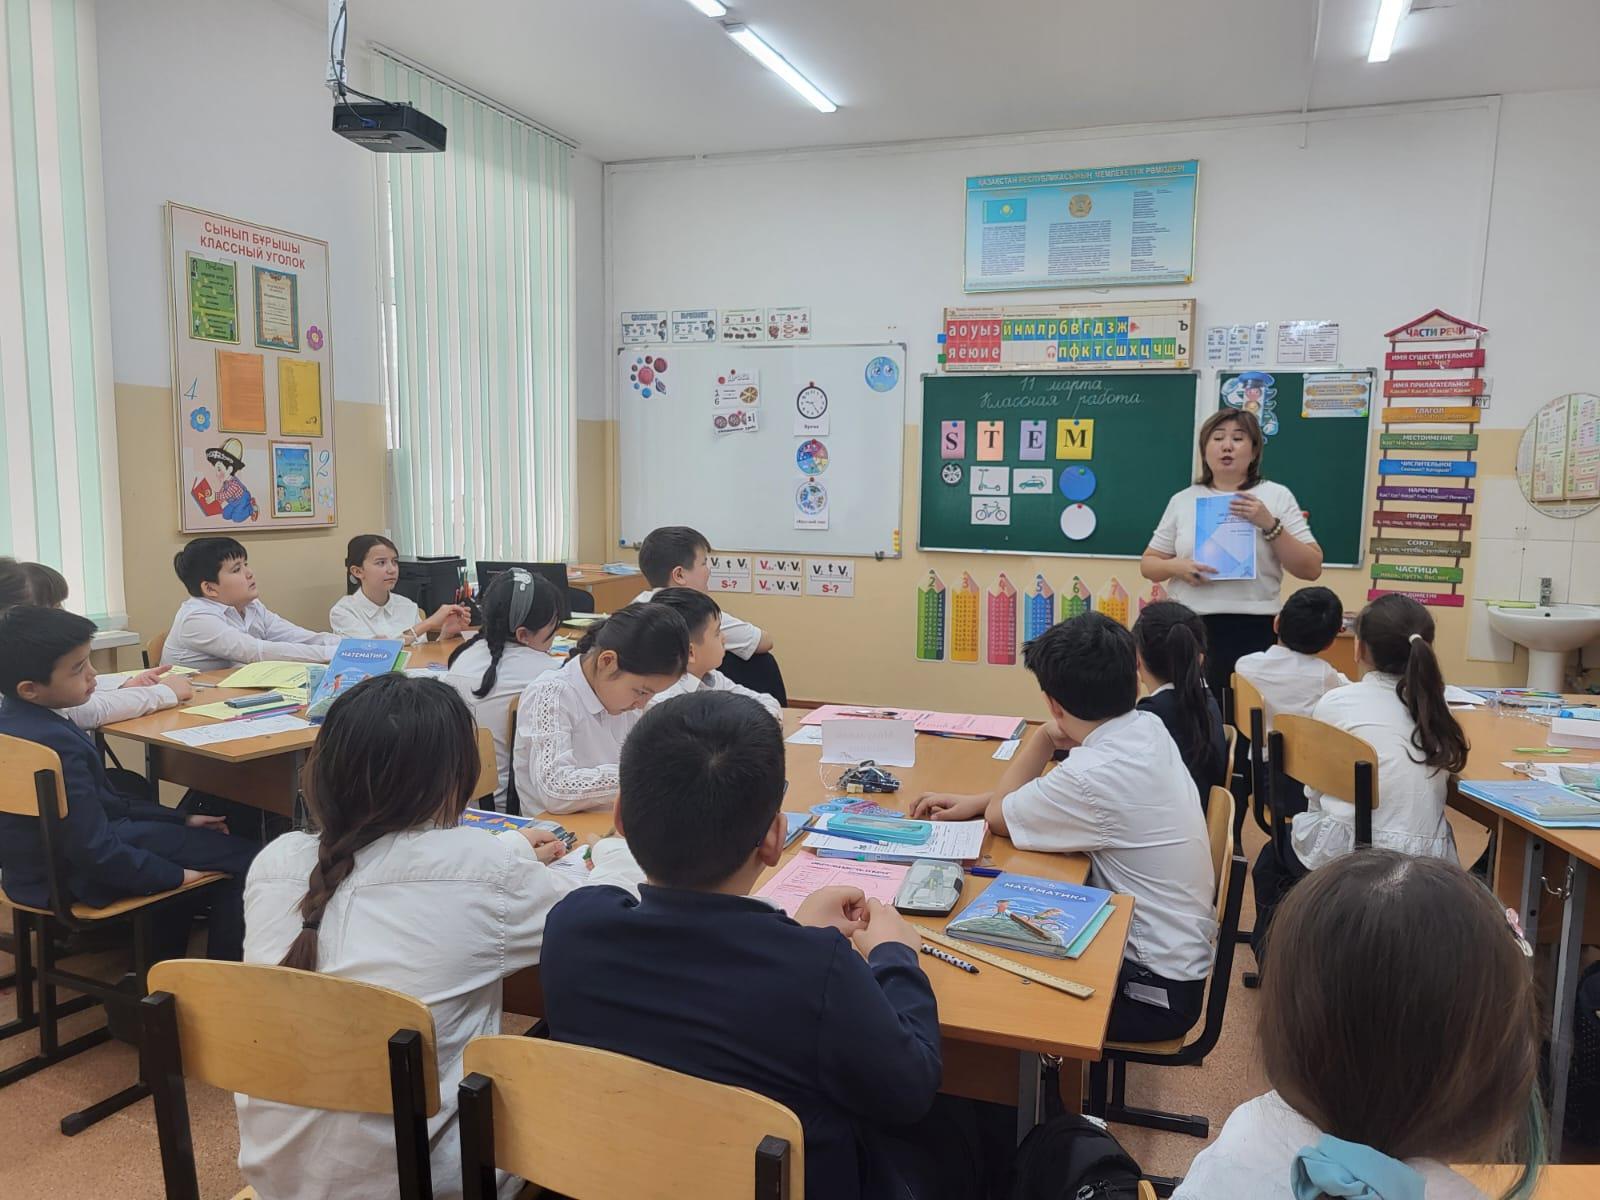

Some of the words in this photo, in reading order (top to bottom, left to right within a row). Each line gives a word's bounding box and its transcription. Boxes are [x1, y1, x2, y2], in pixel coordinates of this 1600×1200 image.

[204, 222, 249, 242] СЫНЫП
[252, 233, 301, 254] БҰРЫШЫ
[200, 235, 263, 259] КЛАССНЫЙ
[266, 251, 305, 270] УГОЛОК
[1406, 327, 1438, 337] ЧАСТИ
[1440, 326, 1466, 336] РЕЧИ
[1408, 352, 1473, 361] СУЩЕСТВИТЕЛЬНОЕ
[1019, 377, 1036, 391] 11
[1047, 379, 1104, 400] марта
[979, 392, 1060, 409] Классная
[1072, 387, 1142, 417] работа
[945, 432, 958, 451] S
[984, 430, 1000, 449] T
[1028, 430, 1042, 449] E
[1064, 429, 1088, 448] M
[1395, 566, 1438, 574] ЧАСТИЦА
[928, 577, 936, 587] 2
[962, 578, 969, 588] 3
[1036, 581, 1043, 592] 5
[1073, 583, 1080, 594] 6
[1152, 585, 1159, 597] 8
[341, 651, 389, 660] МАТЕМАТИКА
[1004, 882, 1088, 903] МАТЕМАТИКА
